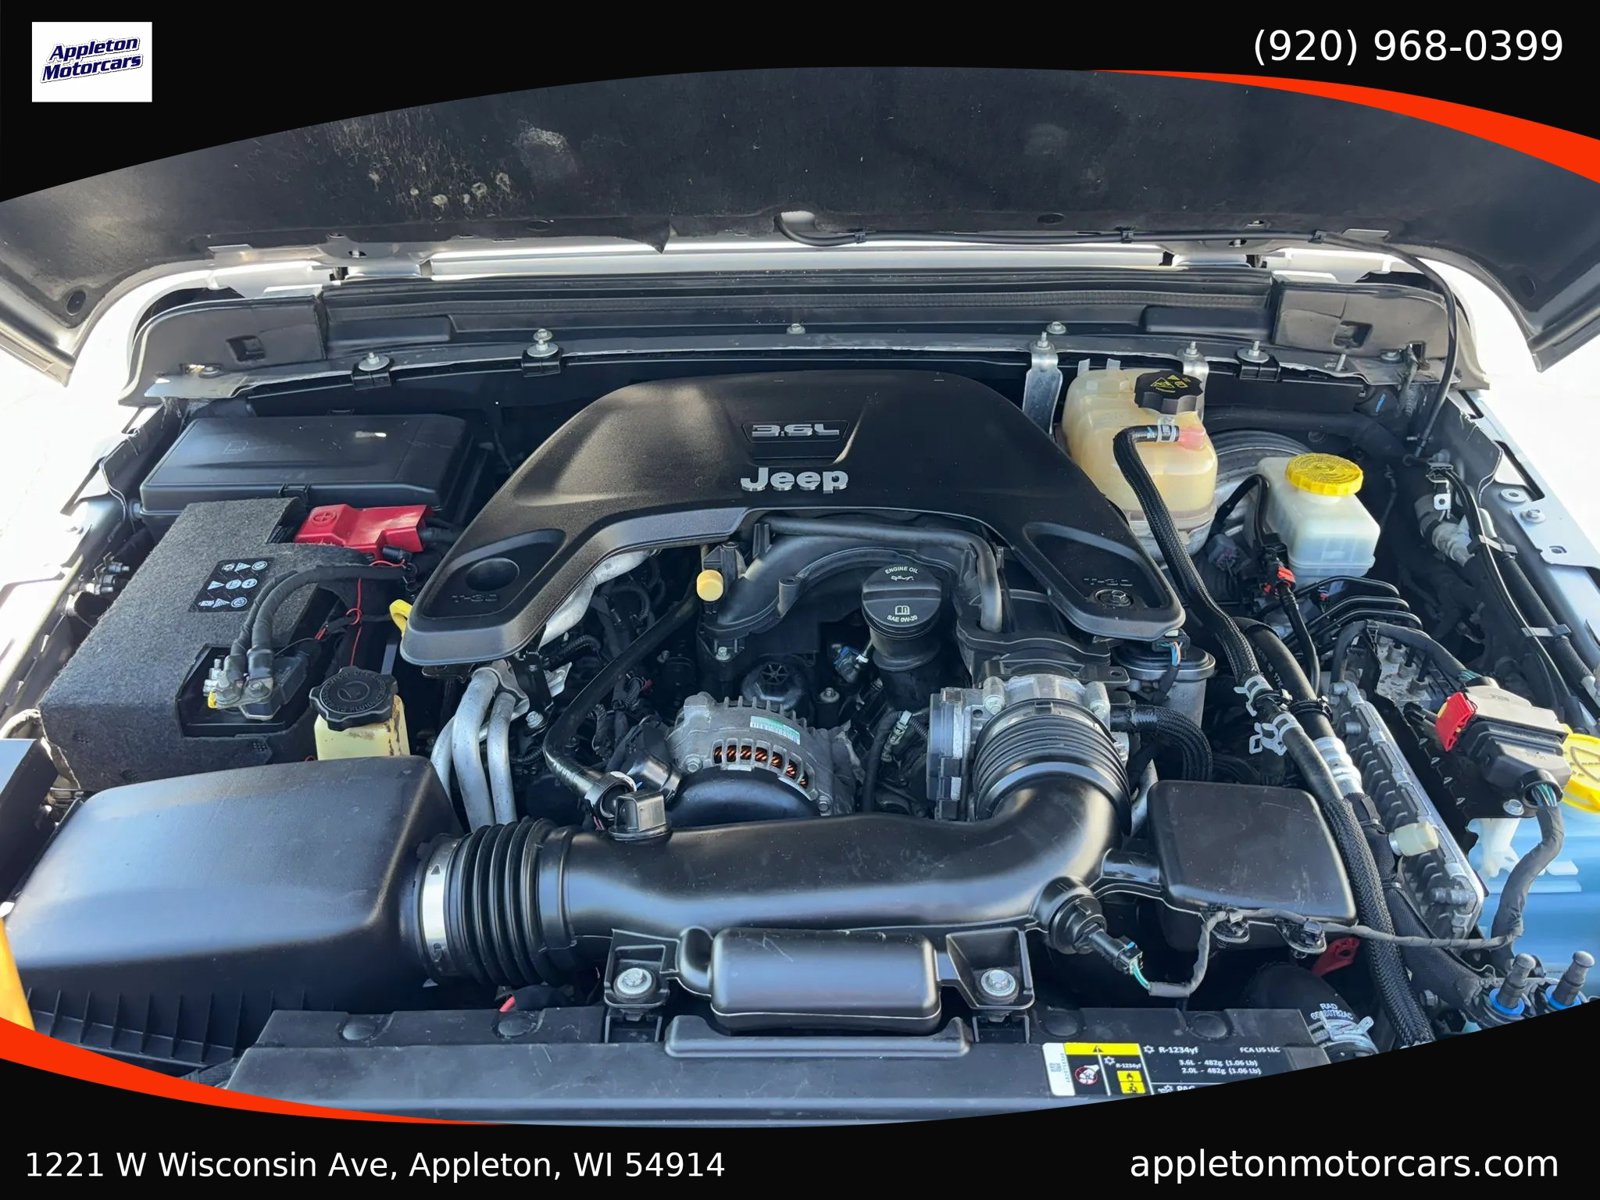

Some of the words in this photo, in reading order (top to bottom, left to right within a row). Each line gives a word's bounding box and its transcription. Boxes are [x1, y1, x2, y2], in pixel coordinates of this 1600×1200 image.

[751, 423, 840, 437] 3.6L
[740, 467, 849, 494] Jeep
[885, 566, 908, 574] ENGINE
[1319, 1002, 1338, 1010] RAD
[1158, 1046, 1199, 1055] R-1234yf
[1204, 1059, 1223, 1067] 482g
[1225, 1059, 1245, 1067] (1.06
[1207, 1067, 1226, 1075] 482g
[1228, 1067, 1248, 1075] (1.06
